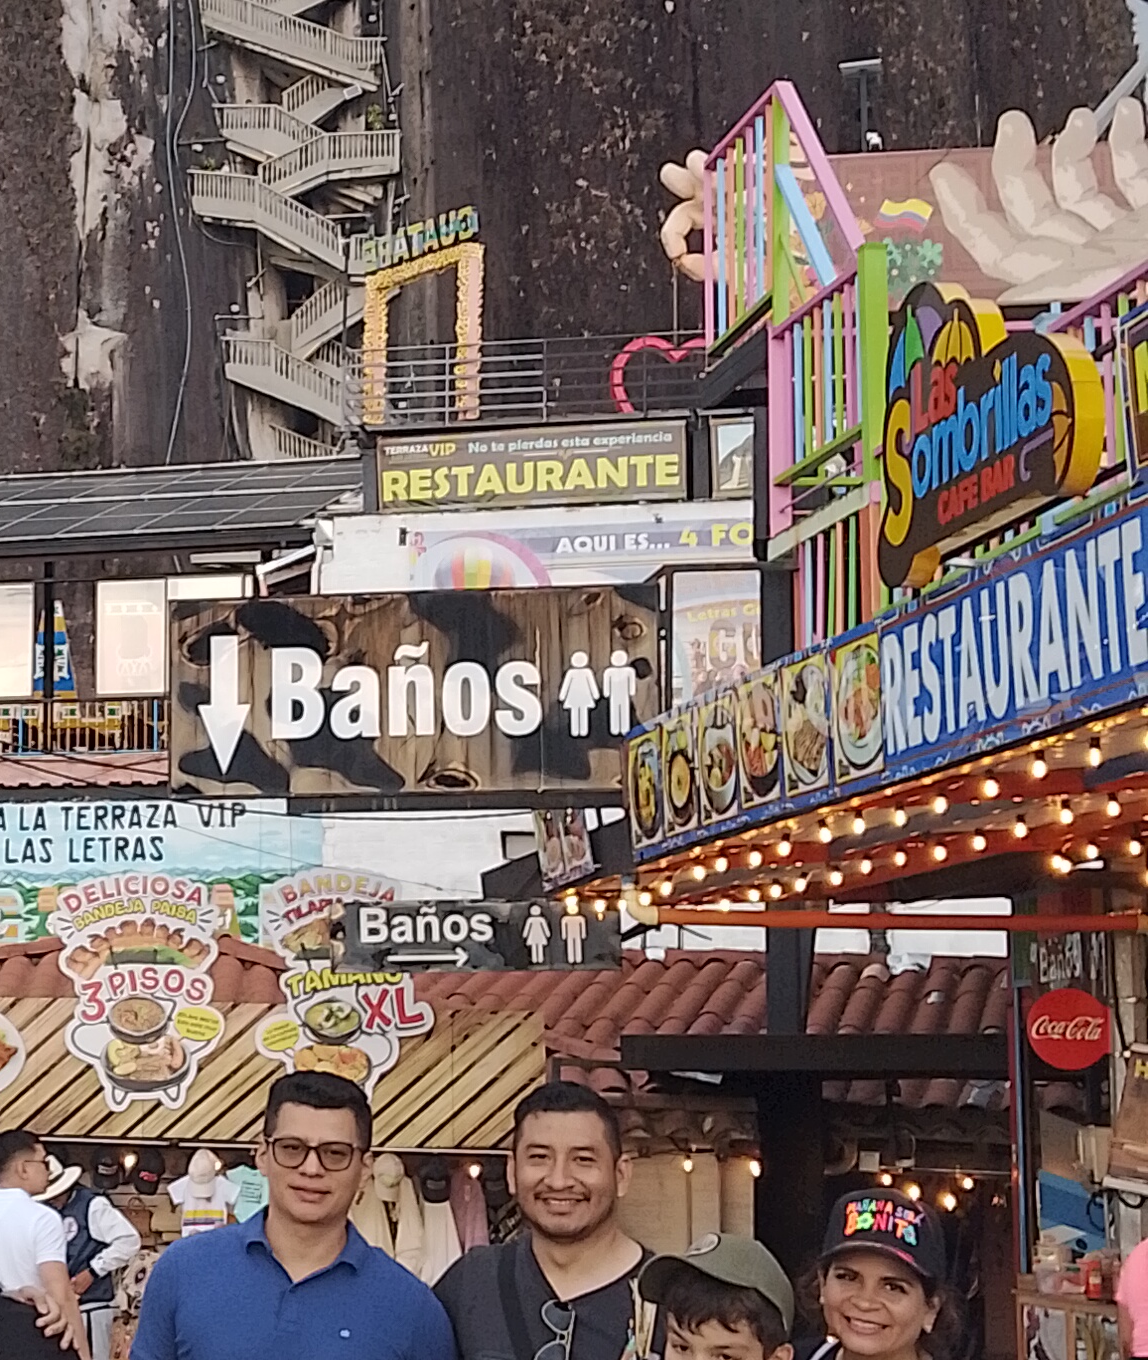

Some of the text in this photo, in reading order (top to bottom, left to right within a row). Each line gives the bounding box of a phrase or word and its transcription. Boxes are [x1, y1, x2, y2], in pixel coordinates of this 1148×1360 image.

[913, 362, 958, 432] Las
[384, 442, 456, 457] TERRAZA VIP
[468, 441, 488, 454] No
[561, 436, 591, 448] esta
[592, 432, 673, 446] experiencia
[884, 353, 1052, 546] Sombrillas
[382, 454, 681, 502] RESTAURANTE
[980, 454, 1015, 502] BAR
[556, 536, 617, 555] AQUI
[679, 526, 699, 548] 4
[881, 515, 1148, 756] RESTAURANTE
[270, 642, 542, 739] Baños
[18, 806, 48, 831] LA
[60, 804, 178, 832] TERRAZA
[196, 803, 246, 829] VIP
[4, 836, 164, 864] LAS LETRAS
[63, 875, 203, 913] DELICIOSA
[280, 875, 395, 903] BANDEJA
[72, 899, 197, 930] BANDEJA PAISA
[359, 903, 493, 943] Baños
[80, 967, 207, 1022] 3 PISOS
[362, 986, 425, 1030] XL
